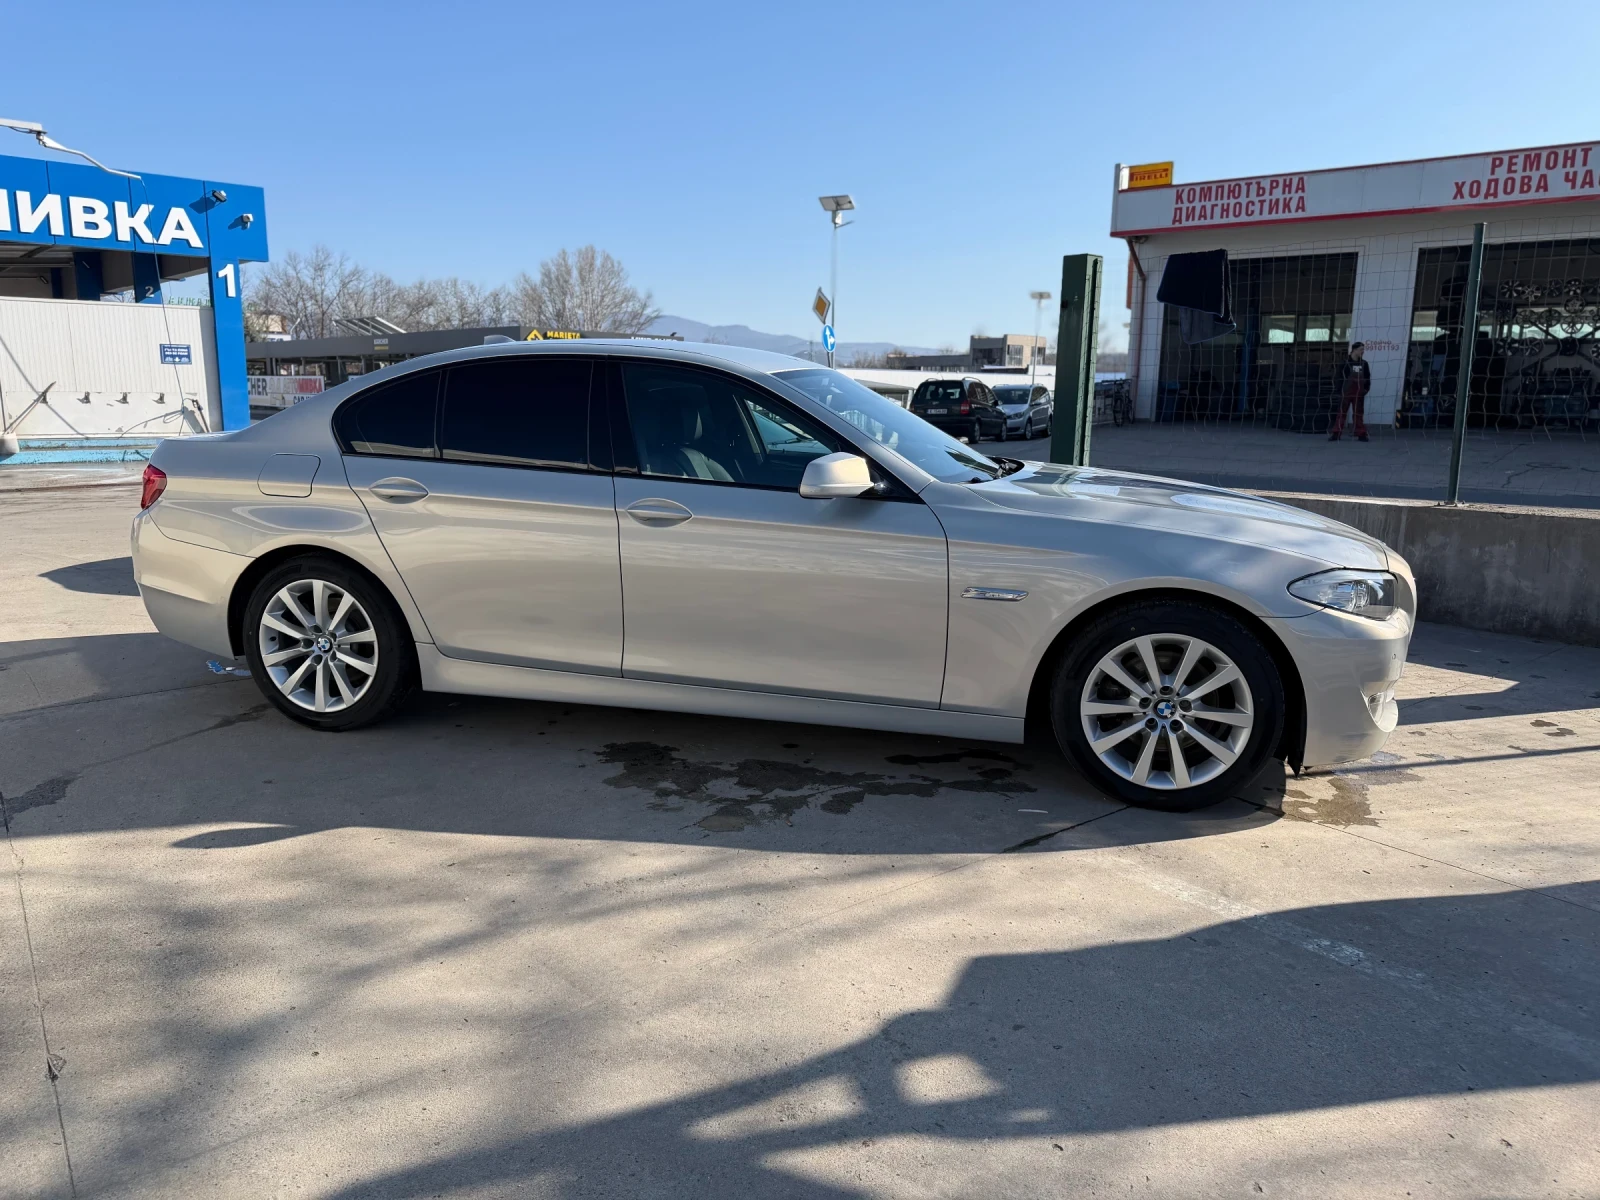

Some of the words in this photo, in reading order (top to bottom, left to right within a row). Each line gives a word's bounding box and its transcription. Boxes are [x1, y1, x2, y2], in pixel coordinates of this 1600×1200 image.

[1130, 168, 1169, 182] PIRELLI
[1490, 147, 1593, 176] РЕМОНТ
[1175, 176, 1306, 205] КОМПЮТЪРНА
[1452, 173, 1549, 200] ХОДОВА
[1564, 169, 1600, 190] ЧА
[1171, 196, 1306, 225] ДИАГНОСТИКА
[145, 285, 154, 298] 2
[217, 263, 236, 298] 1
